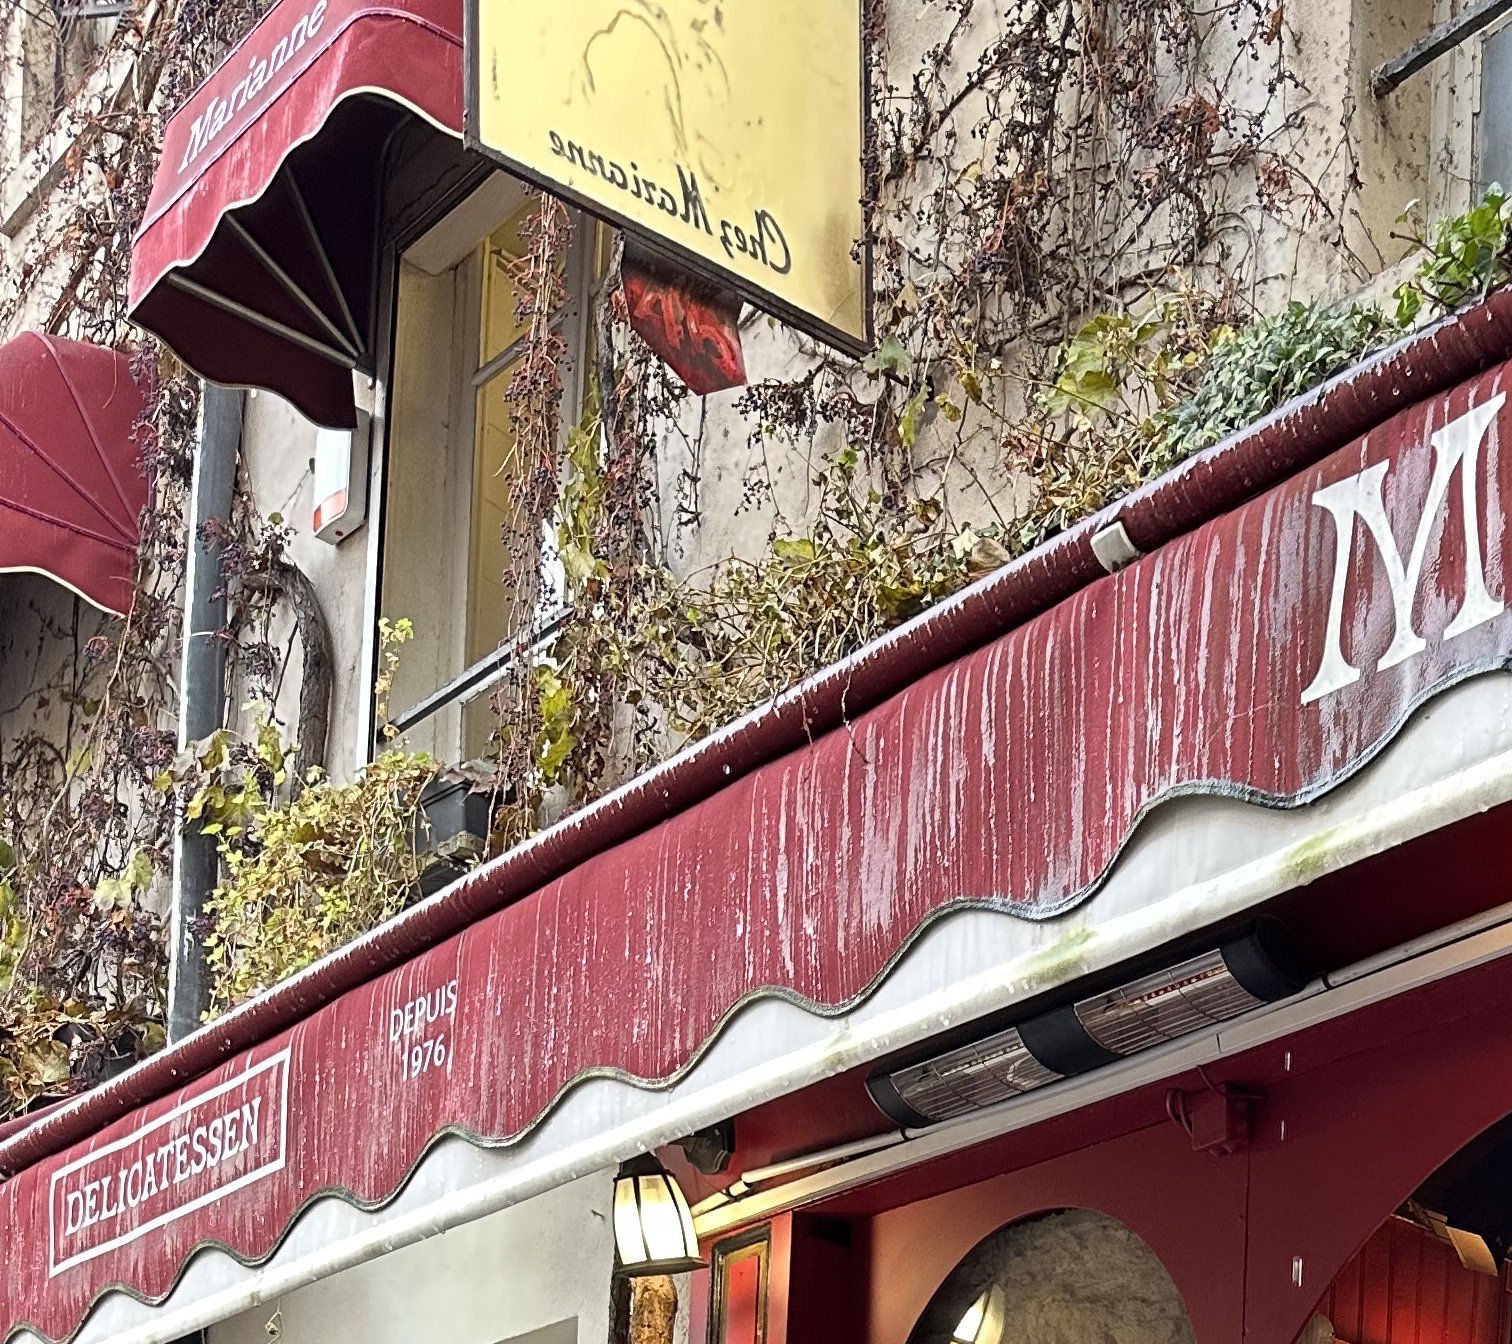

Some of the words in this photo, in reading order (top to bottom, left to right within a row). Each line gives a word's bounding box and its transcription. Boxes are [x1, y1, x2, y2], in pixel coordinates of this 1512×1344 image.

[177, 0, 328, 174] Marianne
[389, 979, 459, 1043] DEPUIS
[401, 1040, 446, 1083] 1976
[64, 1097, 262, 1237] DELICATESSEN
